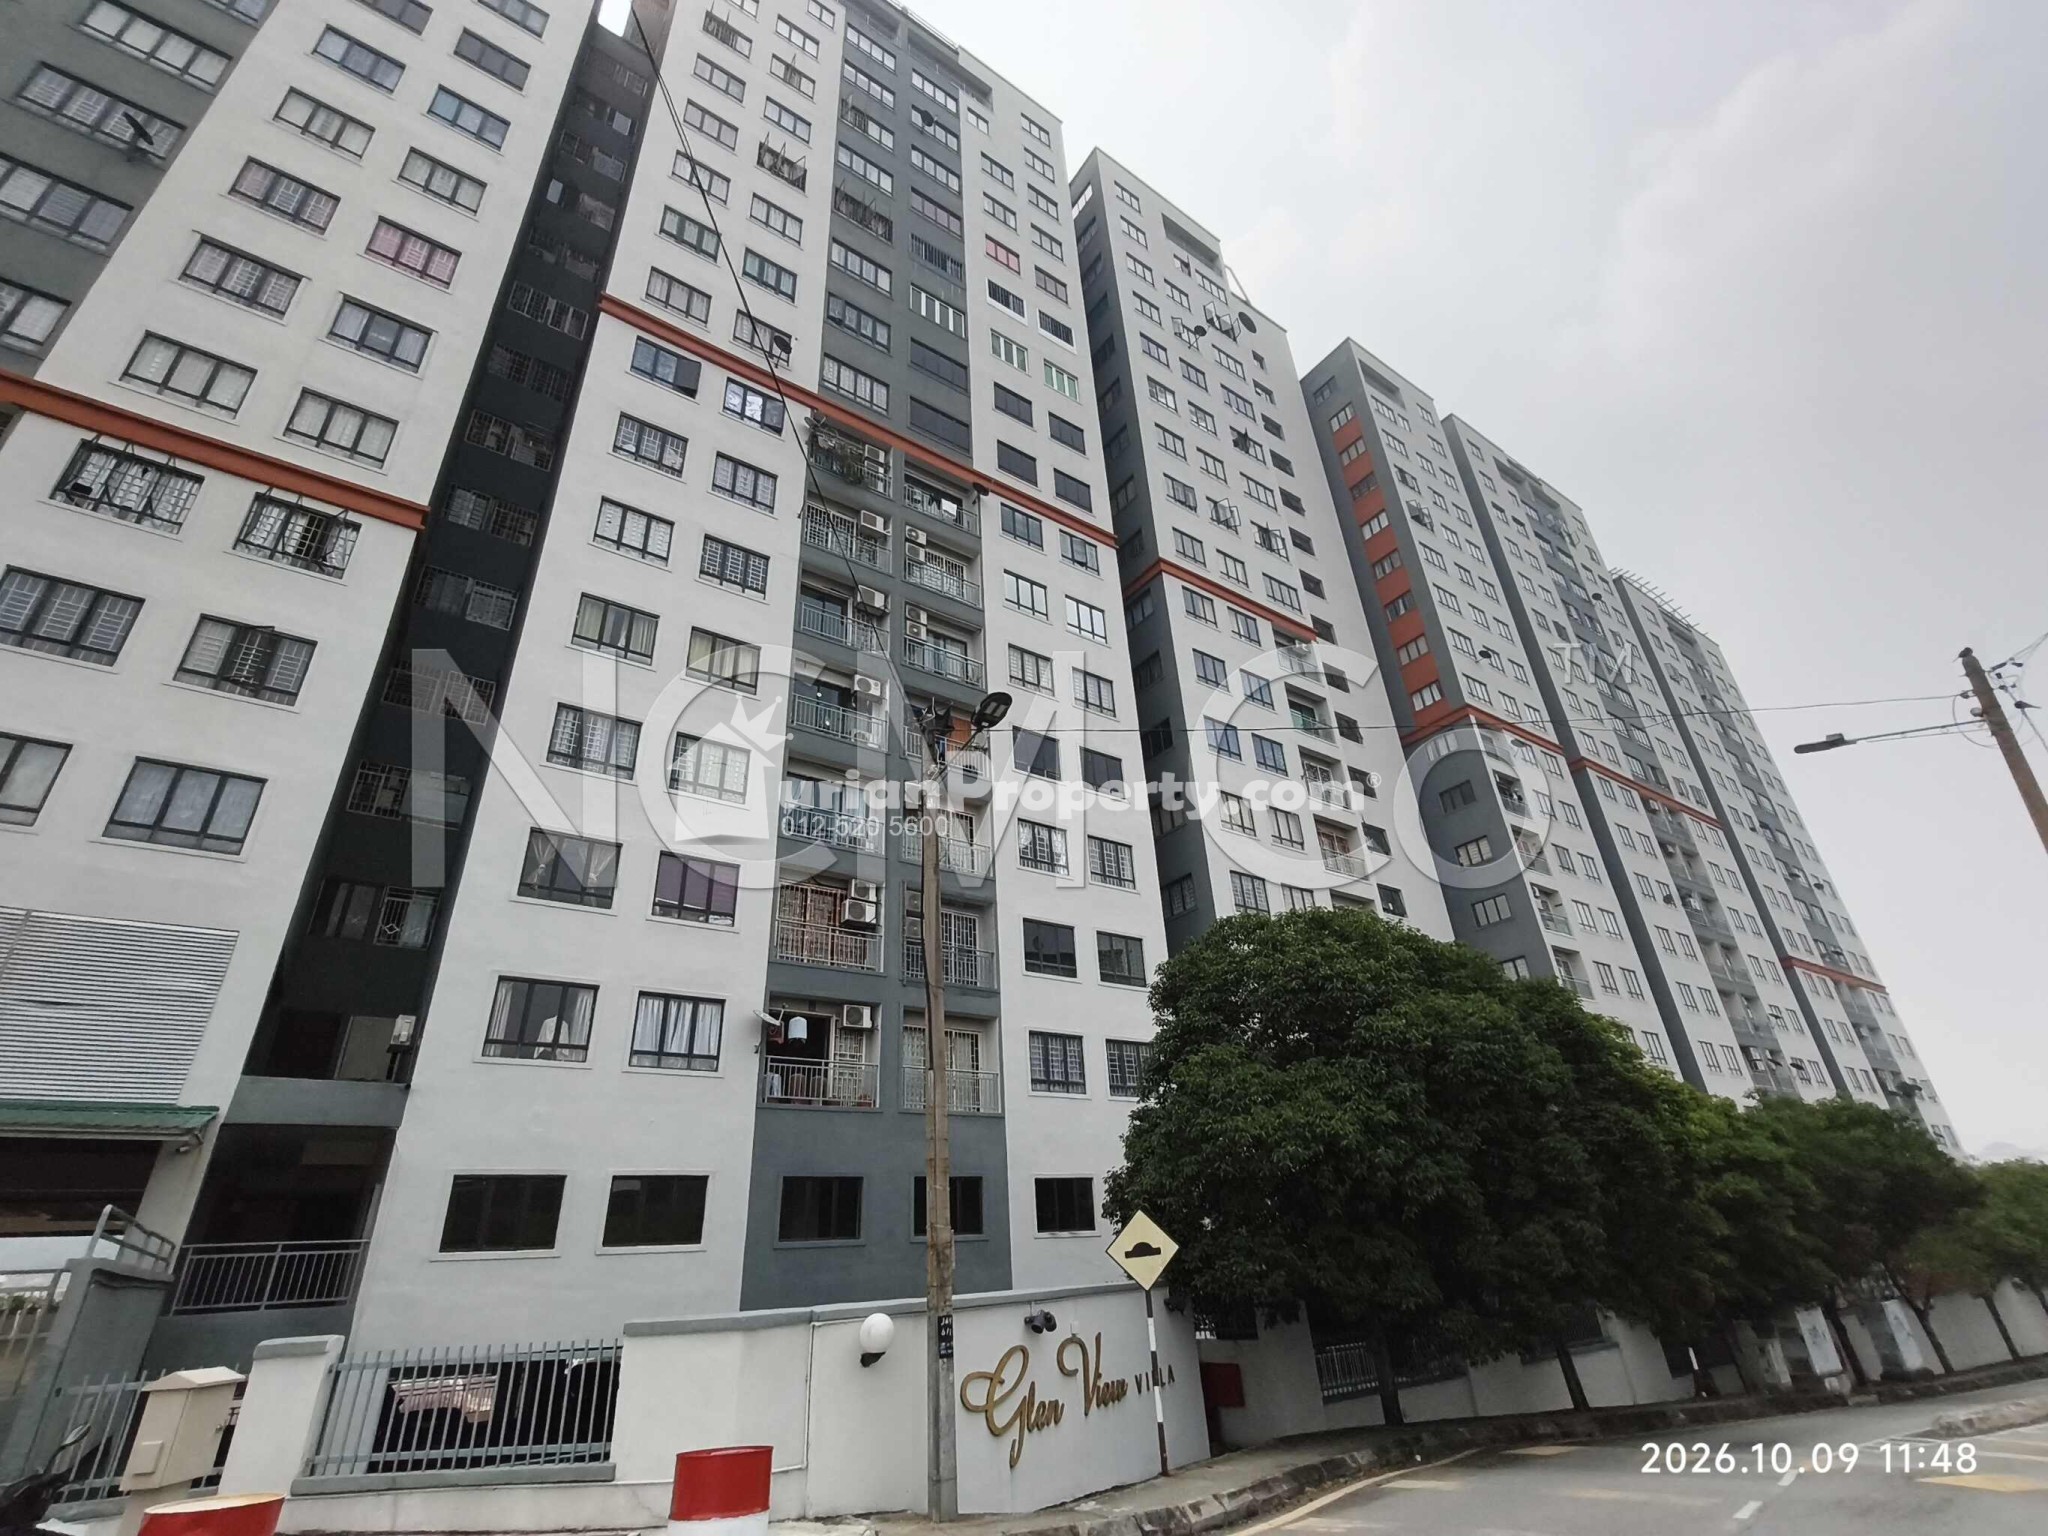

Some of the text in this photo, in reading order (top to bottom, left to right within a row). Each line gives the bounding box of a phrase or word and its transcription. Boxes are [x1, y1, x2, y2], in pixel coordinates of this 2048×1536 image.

[959, 1332, 1176, 1468] Glen View VILA
